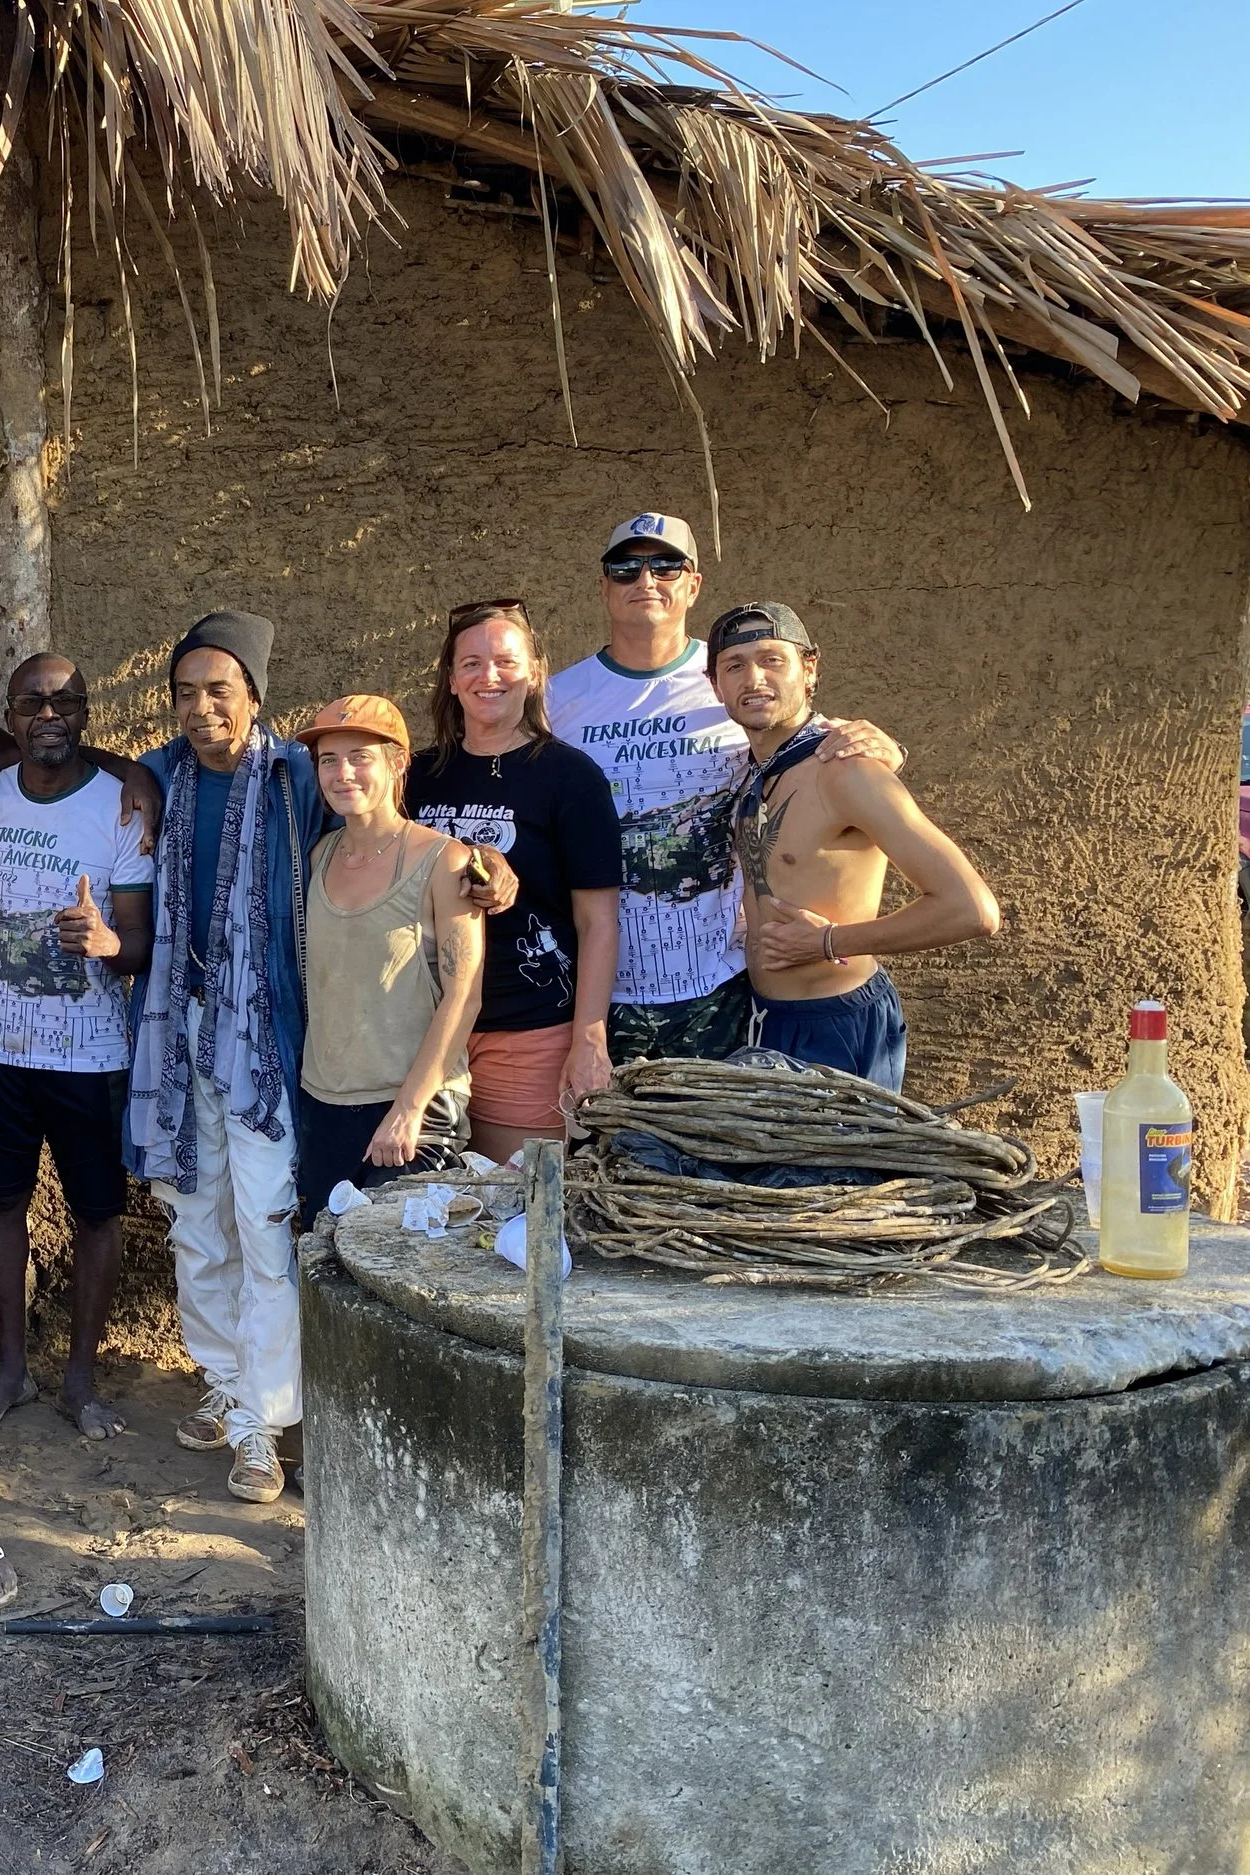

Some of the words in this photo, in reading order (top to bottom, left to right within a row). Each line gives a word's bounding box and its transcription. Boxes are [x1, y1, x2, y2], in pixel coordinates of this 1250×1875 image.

[615, 735, 723, 763] ANCESTRAL
[418, 804, 457, 818] Volta
[461, 804, 514, 820] Miúda
[3, 849, 80, 876] ANCESTRAL
